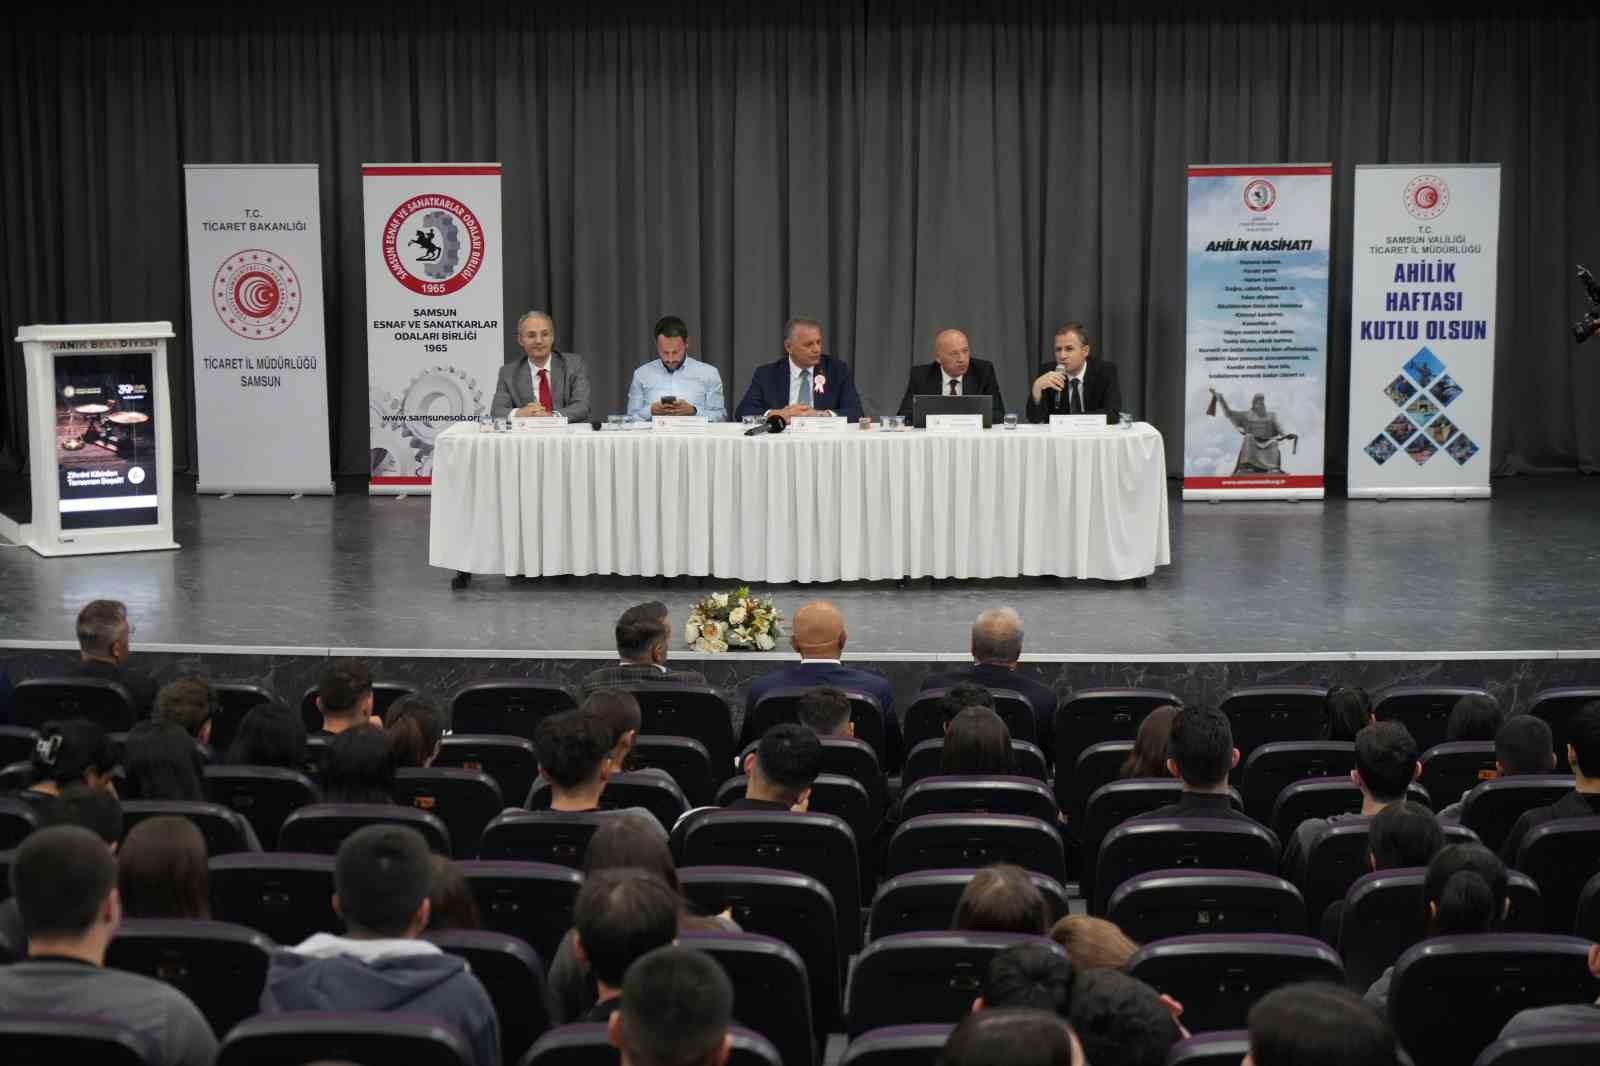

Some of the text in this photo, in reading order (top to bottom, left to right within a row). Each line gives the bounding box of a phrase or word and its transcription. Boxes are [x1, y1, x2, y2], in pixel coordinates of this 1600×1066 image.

[249, 220, 306, 231] BAKANLIĞI
[1206, 238, 1312, 252] AHİLİK NASİHATI
[1386, 236, 1424, 244] SAMSUN
[1394, 259, 1456, 282] AHİLİK
[1386, 292, 1462, 312] HAFTASI
[413, 308, 456, 316] SAMSUN
[424, 320, 498, 328] SANATKARLAR
[394, 332, 439, 340] ODALARI
[1360, 321, 1487, 340] KUTLU OLSUN
[256, 356, 317, 369] MÜDÜRLÜĞÜ
[240, 376, 280, 387] SAMSUN
